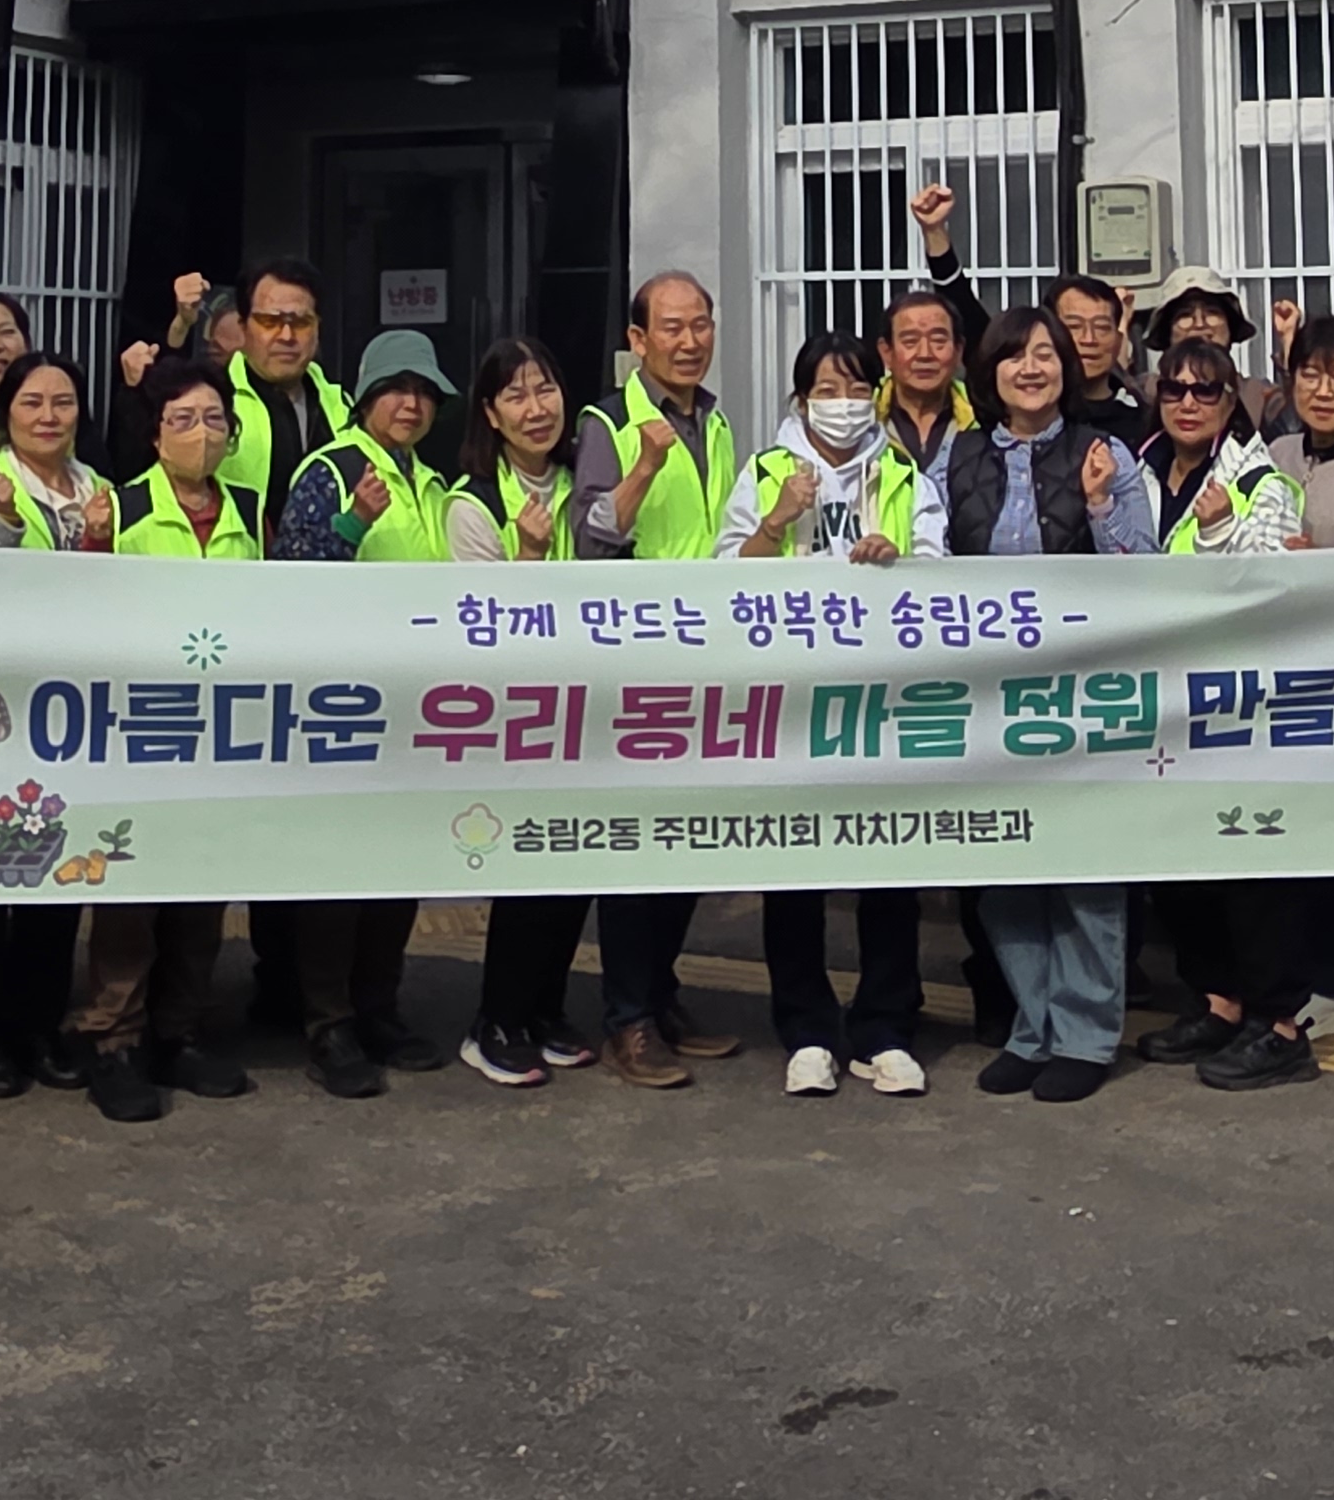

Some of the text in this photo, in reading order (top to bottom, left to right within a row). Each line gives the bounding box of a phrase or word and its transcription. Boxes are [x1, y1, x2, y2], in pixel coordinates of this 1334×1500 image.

[456, 593, 557, 647] 함께
[580, 597, 707, 646] 만드는
[729, 590, 869, 650] 행복한
[890, 590, 1043, 650] 송림2동
[28, 680, 387, 765] 아름다운
[412, 683, 587, 762] 우리
[612, 684, 784, 760] 동네
[810, 681, 973, 758] 마을
[1000, 671, 1159, 756] 정원
[512, 808, 1034, 853] 송림2동 주민자치회 자치기획분과
